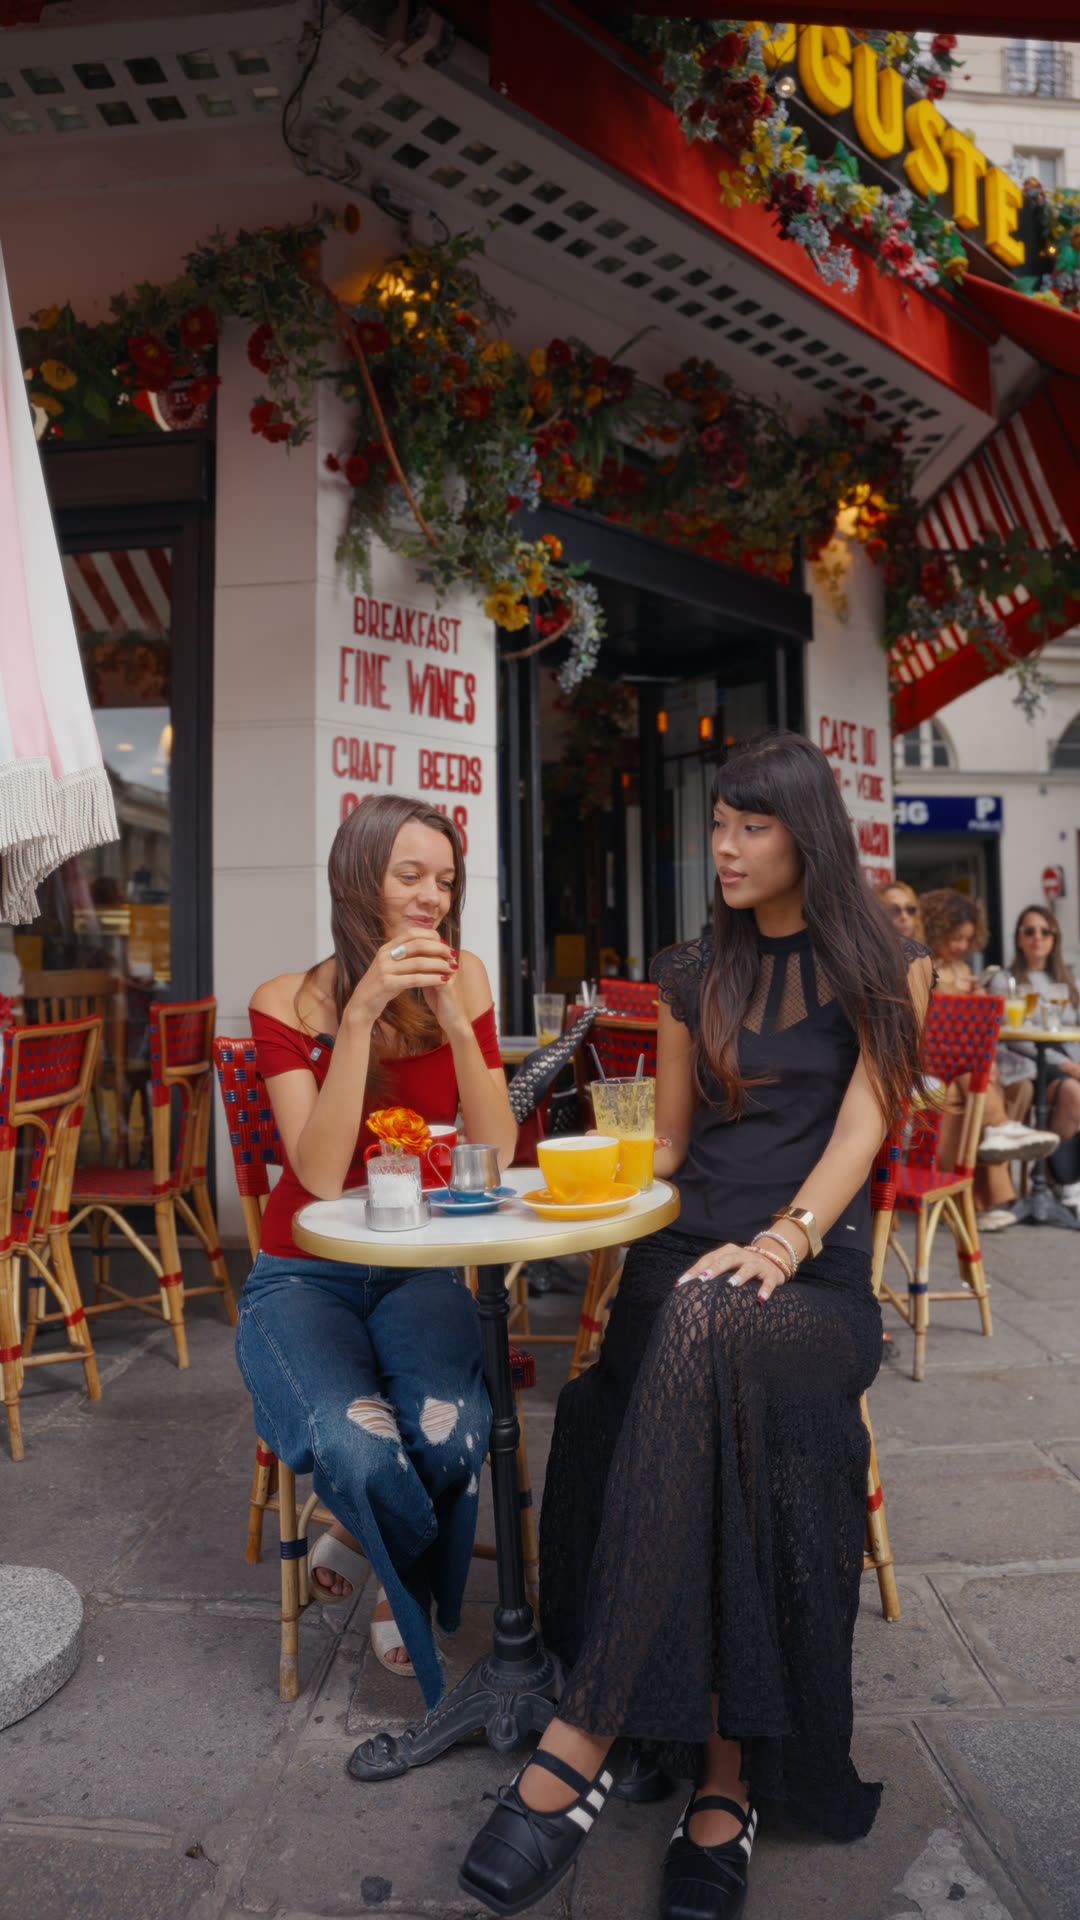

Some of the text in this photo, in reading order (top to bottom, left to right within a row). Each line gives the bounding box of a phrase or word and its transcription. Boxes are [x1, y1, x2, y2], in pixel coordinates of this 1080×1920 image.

[353, 596, 461, 654] BREAKFAST
[333, 735, 483, 796] CRAFT BEERS
[975, 797, 996, 819] P
